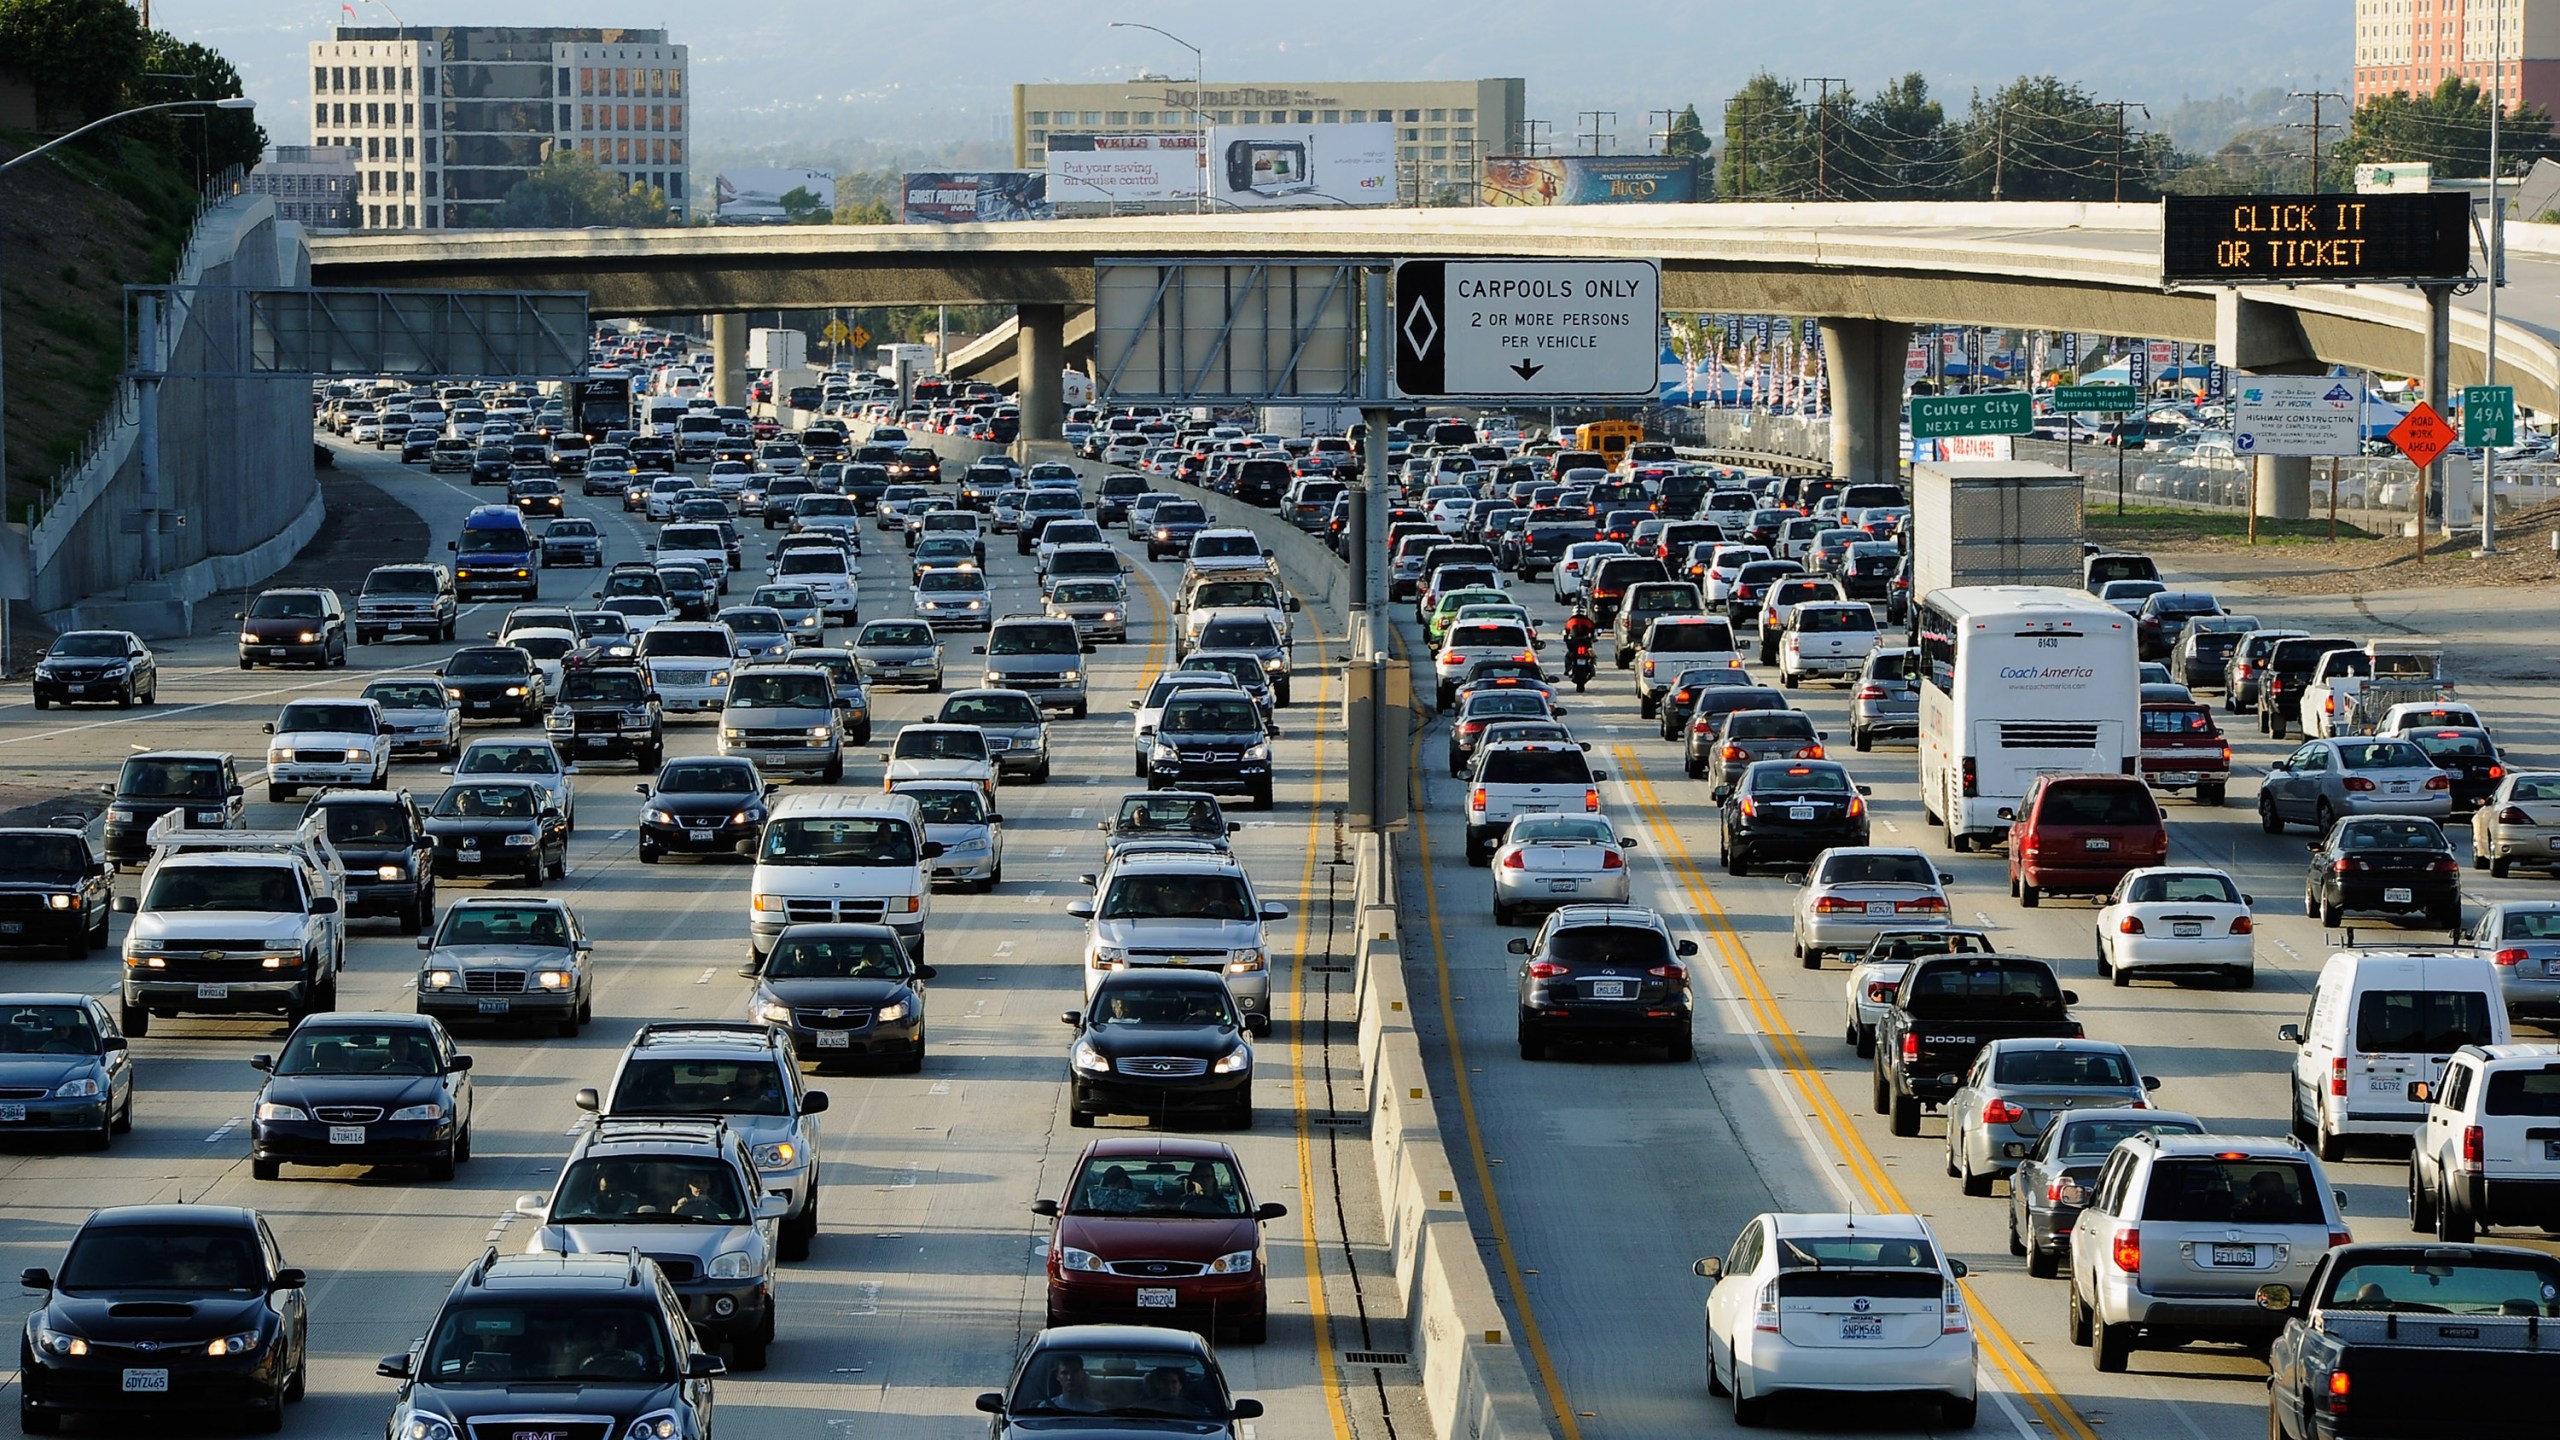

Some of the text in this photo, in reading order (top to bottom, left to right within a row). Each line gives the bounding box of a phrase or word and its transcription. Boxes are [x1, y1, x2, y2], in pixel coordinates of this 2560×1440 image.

[1094, 138, 1148, 150] WELLS
[1064, 162, 1152, 176] Put your saving
[1064, 173, 1159, 186] on cruise control
[1611, 180, 1656, 197] HUGO
[908, 190, 977, 204] GHOST PROTOCOL
[2234, 204, 2366, 232] CLICK IT
[2217, 239, 2366, 267] OR TICKET
[1458, 280, 1640, 298] CARPOOLS ONLY
[1471, 312, 1630, 327] 2 OR MORE PERSONS
[1729, 321, 1738, 348] FORD
[1502, 336, 1598, 348] PER VEHICLE
[2066, 334, 2076, 364] FORD
[2132, 353, 2143, 386] FORD
[2063, 390, 2093, 398] Nathan
[2470, 390, 2507, 403] EXIT
[1922, 400, 2020, 416] Culver City
[2056, 400, 2134, 409] Memorial Highway
[2286, 415, 2354, 423] CONSTRUCTION
[2473, 408, 2504, 422] 49A
[1925, 419, 2019, 432] NEXT 4 EXITS
[2411, 417, 2433, 426] ROAD
[2409, 429, 2433, 438] WORK
[2408, 442, 2436, 452] AHEAD
[2038, 638, 2058, 648] 61430
[2000, 666, 2094, 678] Coach America
[1925, 1036, 1976, 1044] DODGE
[331, 1133, 363, 1143] 4TUH116
[1139, 1294, 1174, 1305] 5MDS204
[1842, 1323, 1881, 1335] 6NPM568
[2449, 1329, 2476, 1337] HUSKY
[125, 1377, 165, 1388] 6DYZ465
[512, 1431, 569, 1440] GMC
